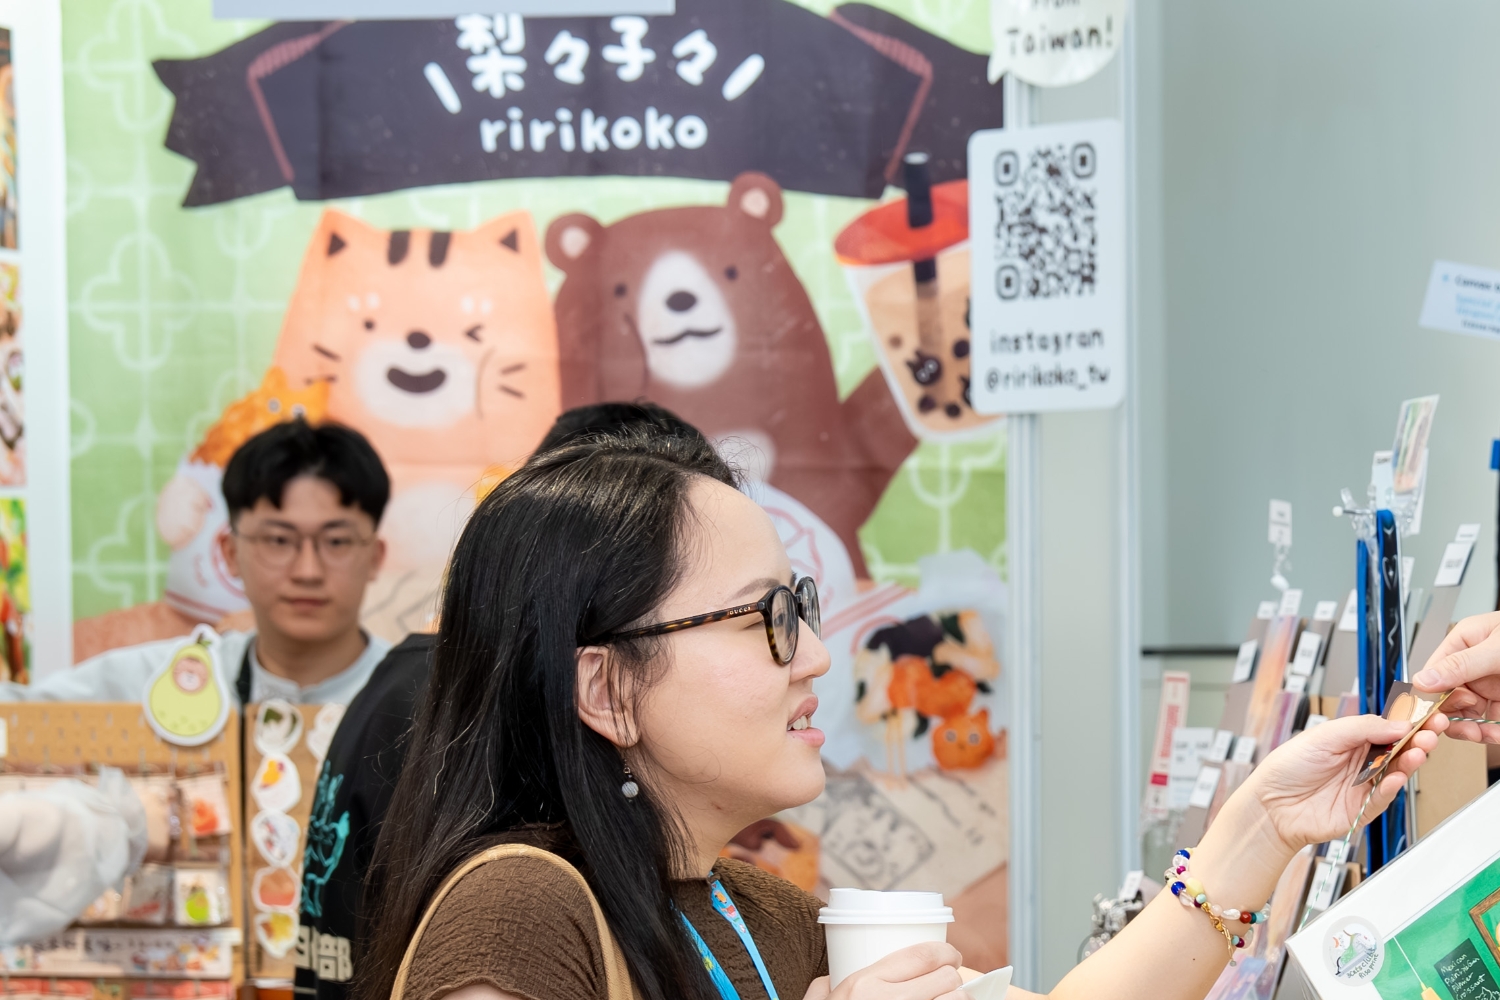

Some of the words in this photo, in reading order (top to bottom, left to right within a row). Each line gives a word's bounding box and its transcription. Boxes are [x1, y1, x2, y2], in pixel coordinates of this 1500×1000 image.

[1005, 14, 1113, 58] Taiwan!
[479, 106, 709, 154] ririkoko
[985, 362, 1112, 393] @ririkoko_tw
